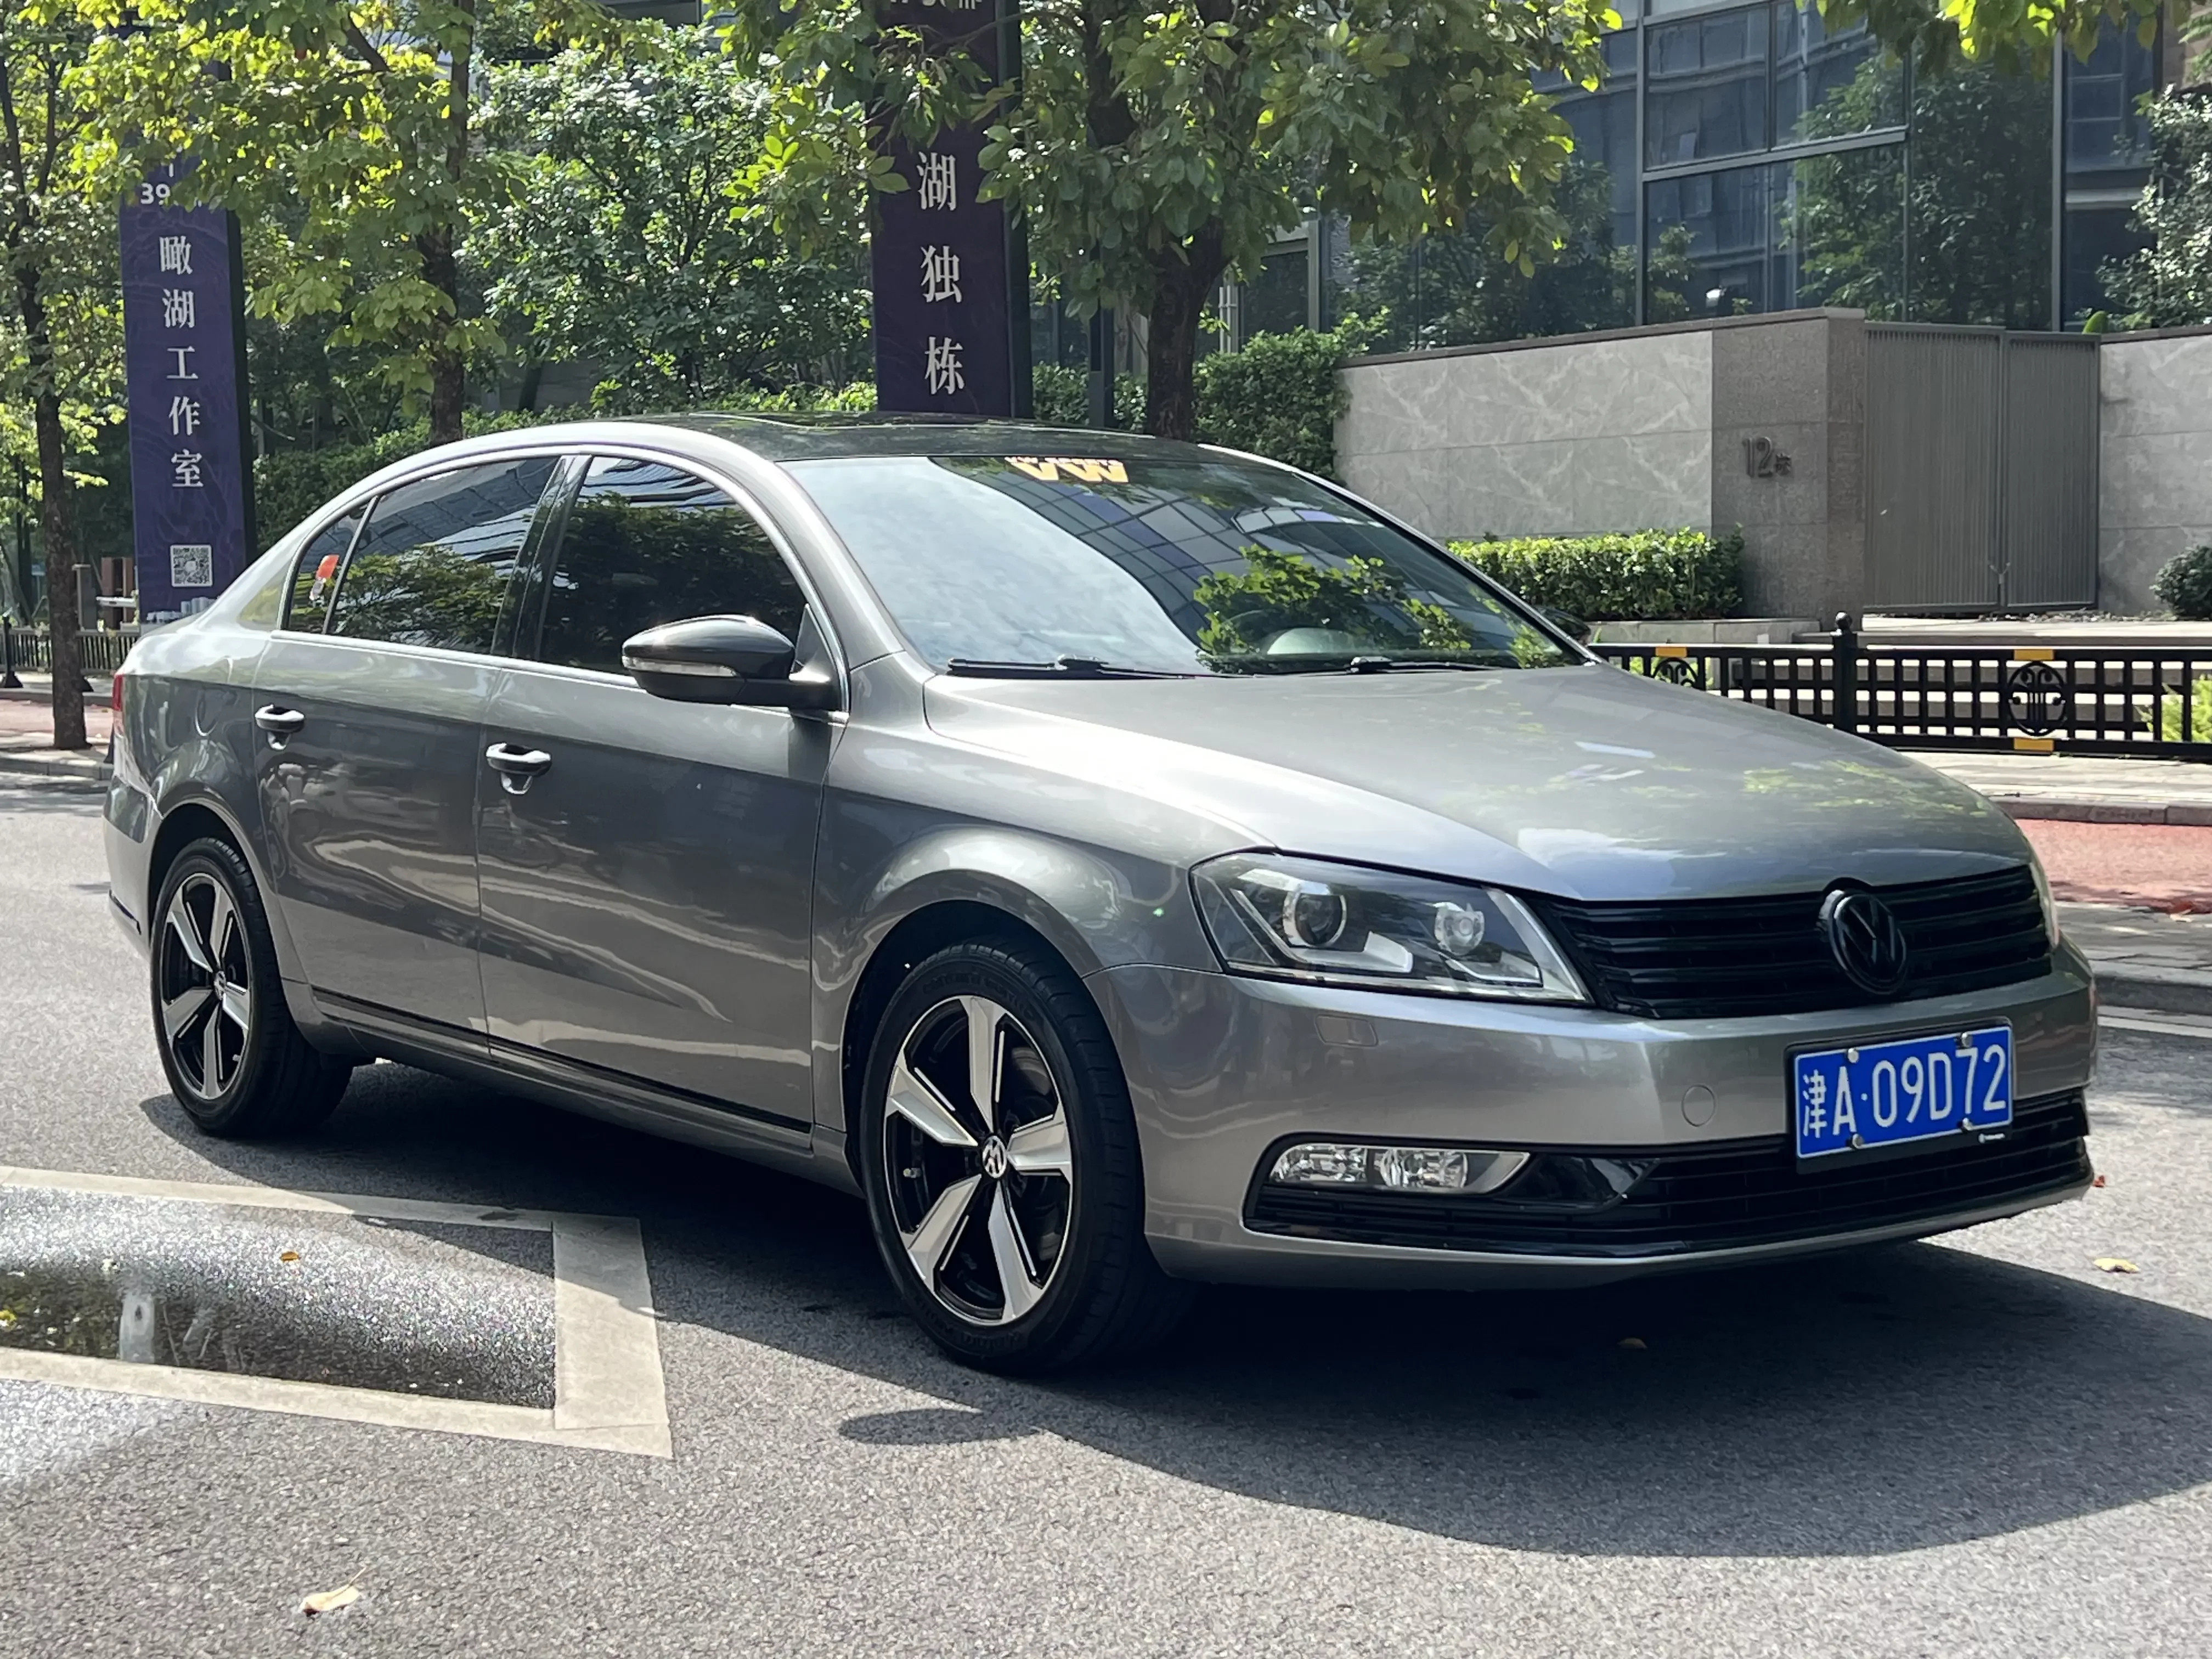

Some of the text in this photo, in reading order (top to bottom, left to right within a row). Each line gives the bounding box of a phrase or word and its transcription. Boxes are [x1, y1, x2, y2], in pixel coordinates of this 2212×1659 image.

[159, 235, 204, 488] 瞰湖工作室
[917, 151, 964, 395] 湖独栋
[1803, 1043, 2006, 1138] 津A·09D72
